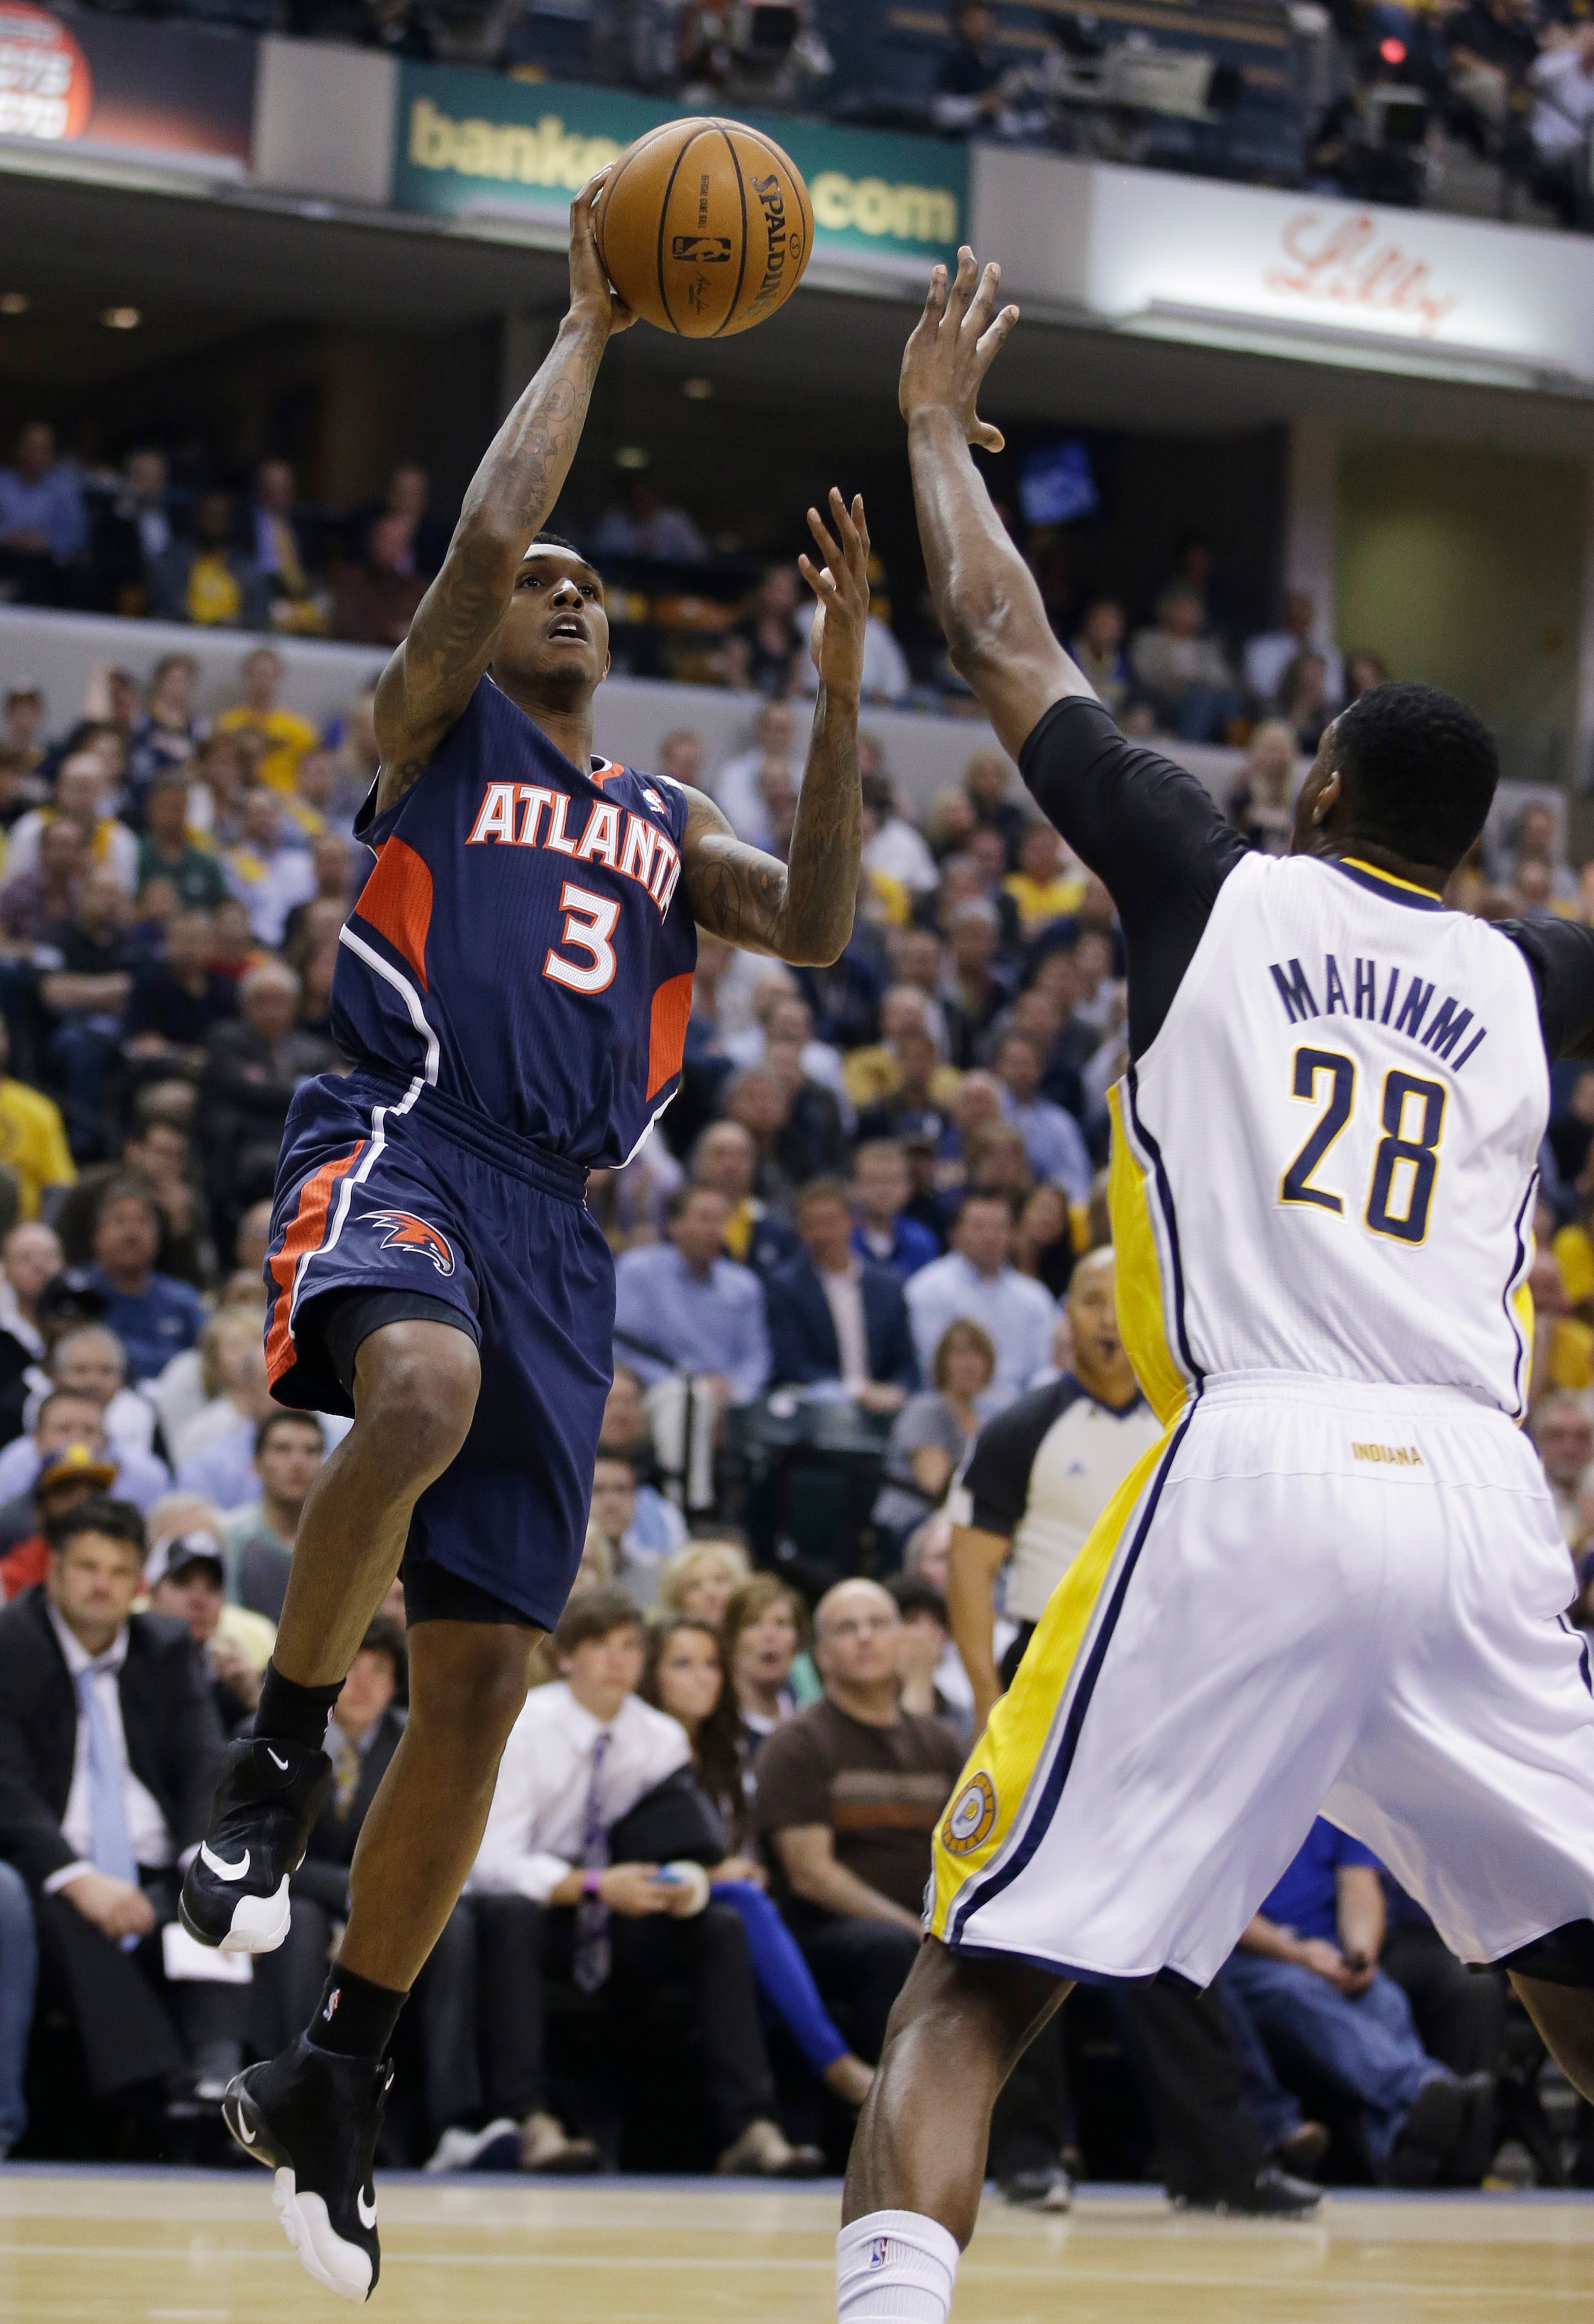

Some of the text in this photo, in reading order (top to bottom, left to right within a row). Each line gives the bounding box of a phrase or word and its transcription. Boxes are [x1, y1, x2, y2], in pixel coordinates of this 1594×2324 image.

[409, 98, 957, 244] banke com
[743, 174, 785, 317] SPALDING
[542, 880, 621, 995] 3
[1269, 954, 1487, 1074] MAHINMI
[1279, 1045, 1447, 1246] 28
[1352, 1441, 1424, 1466] INDIANA
